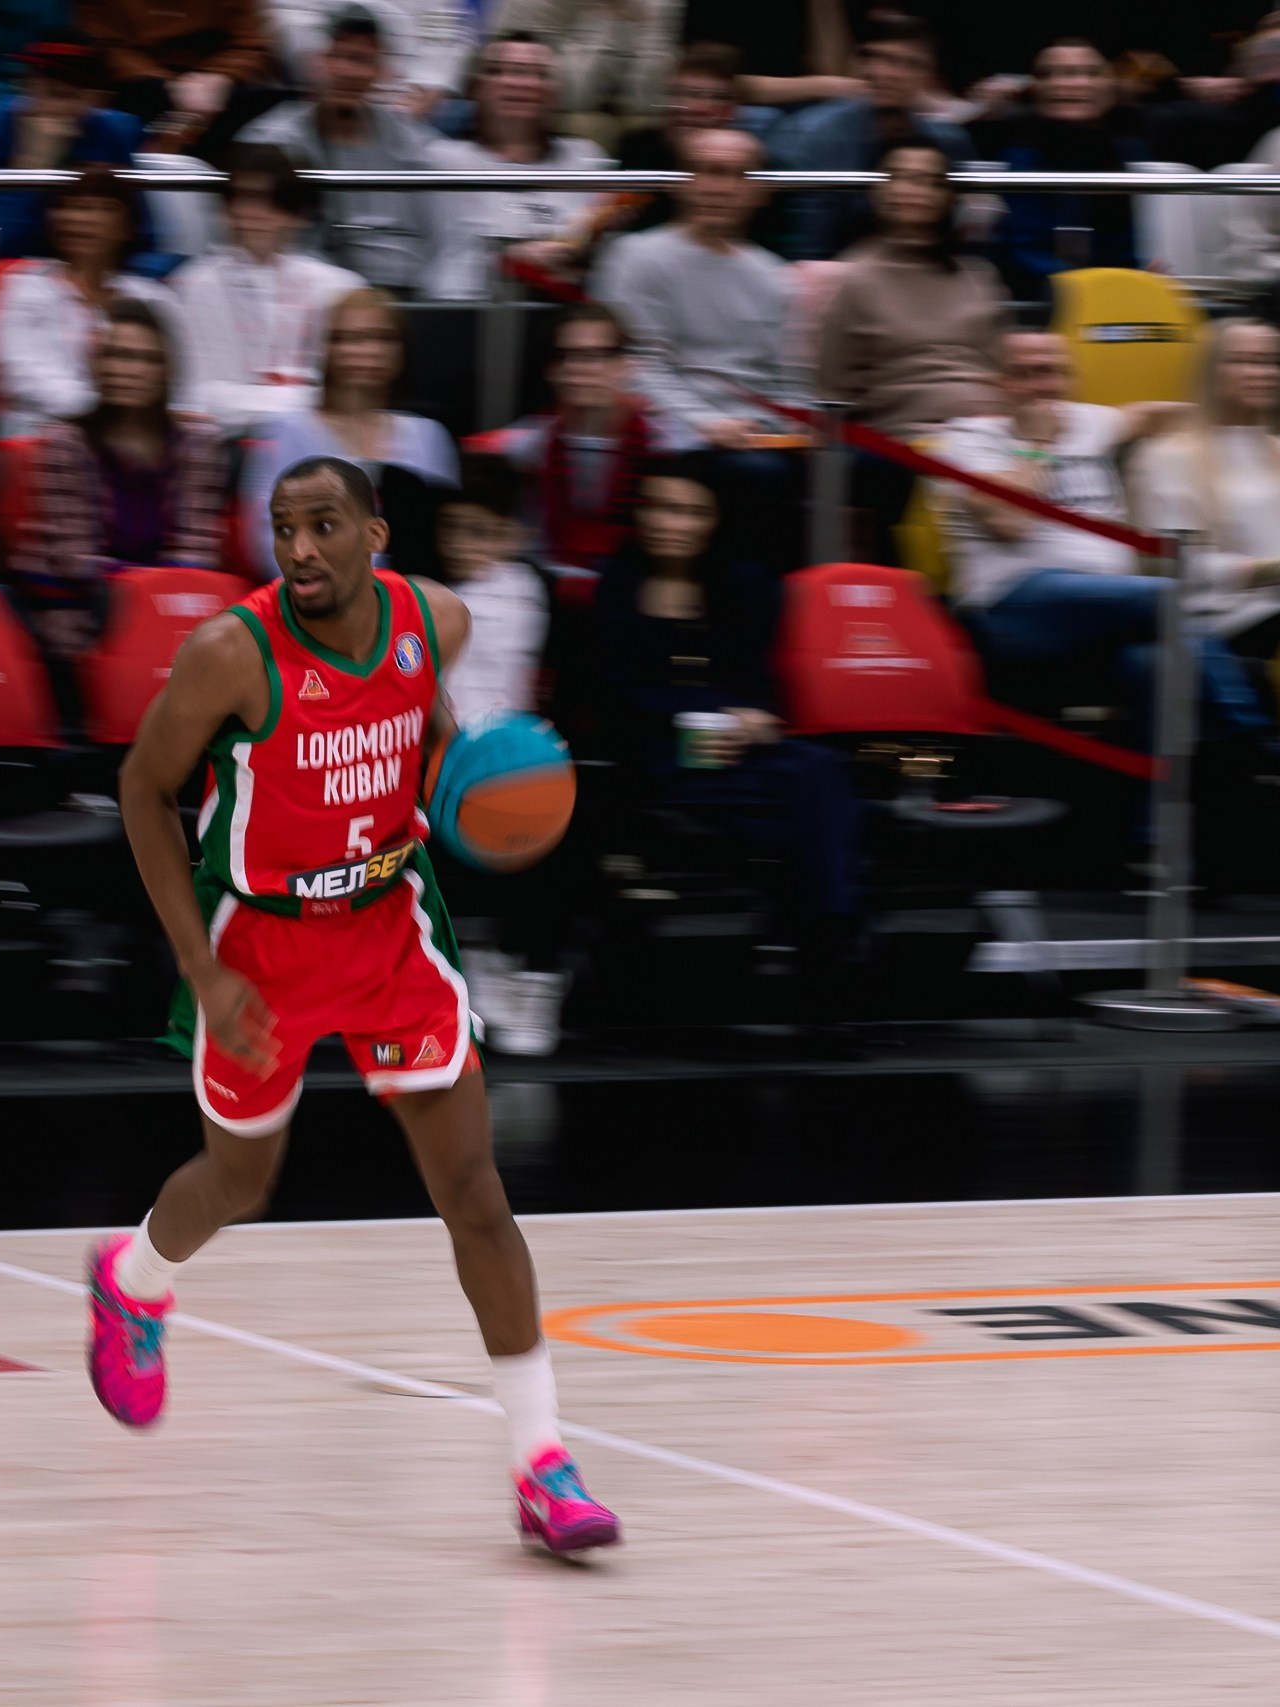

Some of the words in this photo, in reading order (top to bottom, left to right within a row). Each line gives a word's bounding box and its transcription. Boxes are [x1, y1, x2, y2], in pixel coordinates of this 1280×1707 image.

[297, 705, 423, 770] LOKOMOTIV
[324, 753, 401, 806] KUBAN
[344, 814, 375, 860] 5
